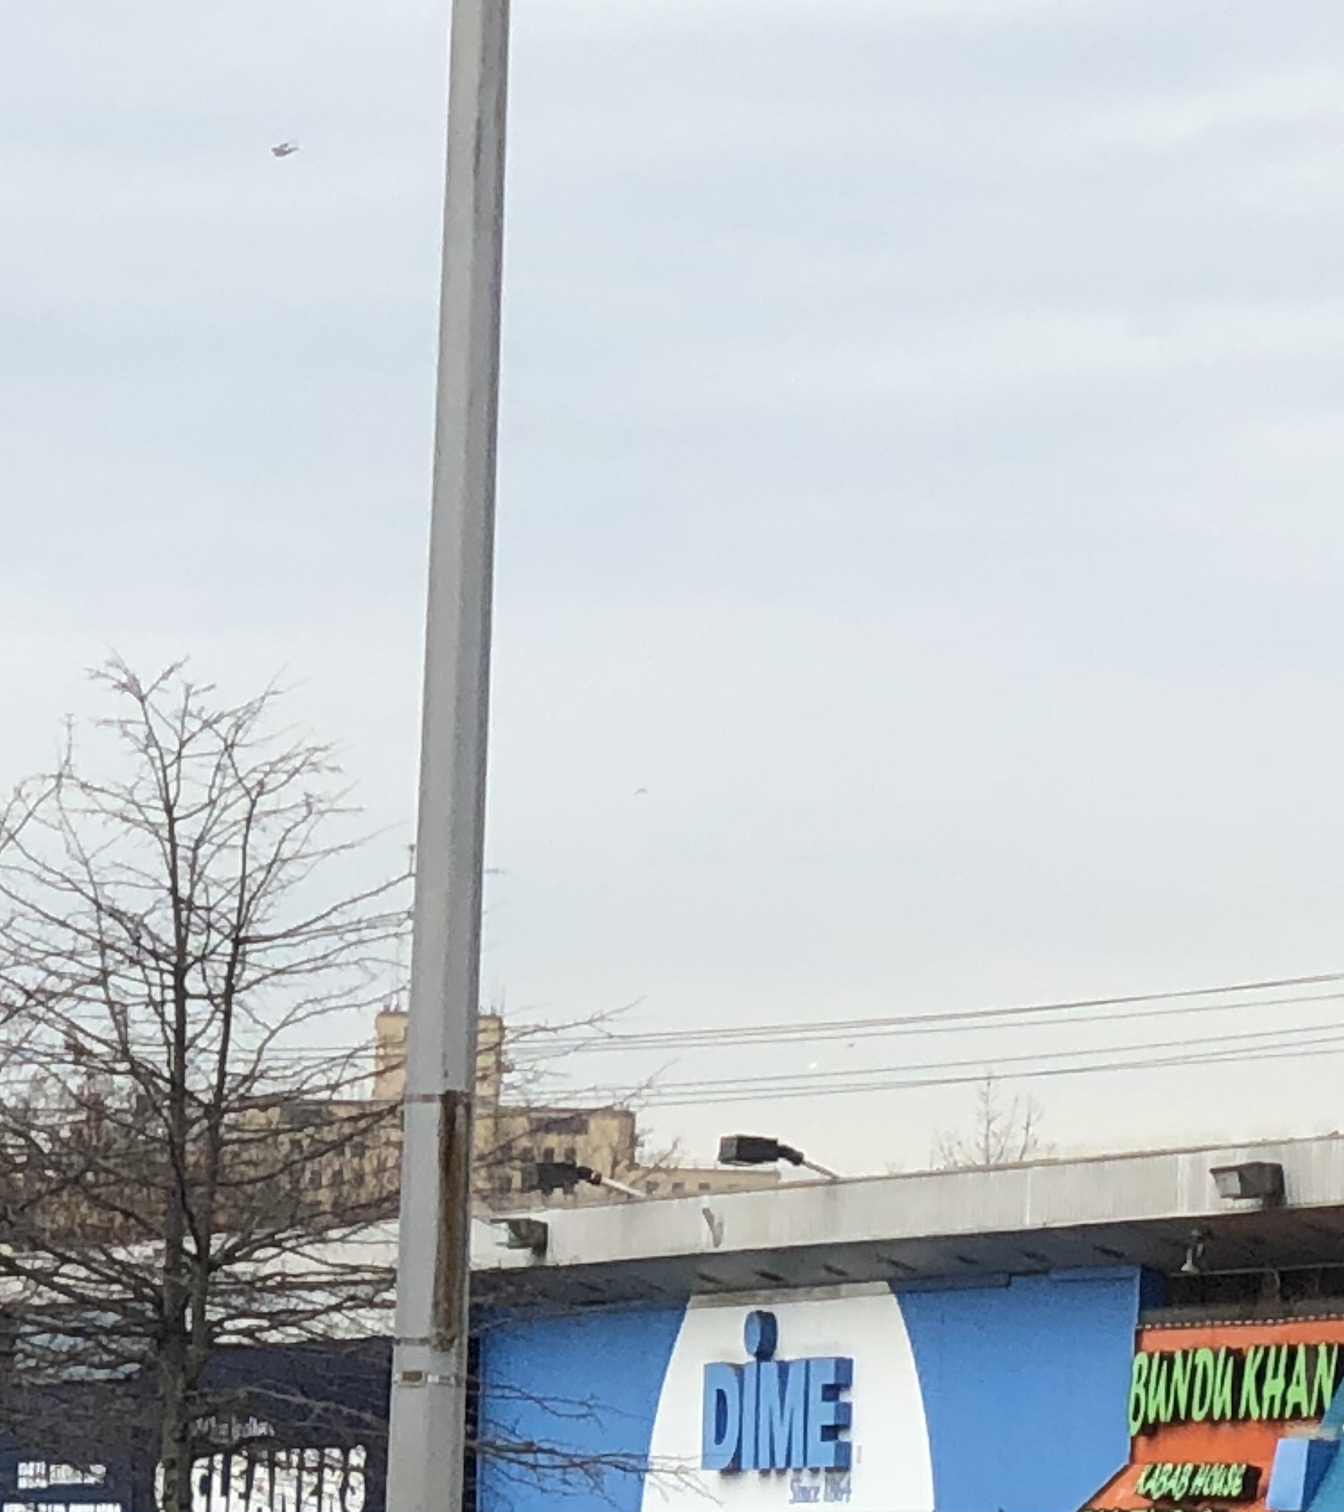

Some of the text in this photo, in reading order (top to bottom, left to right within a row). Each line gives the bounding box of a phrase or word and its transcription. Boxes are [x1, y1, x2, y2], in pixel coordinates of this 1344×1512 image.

[701, 1310, 854, 1472] DIME
[1128, 1342, 1339, 1437] BUNDU KHAN
